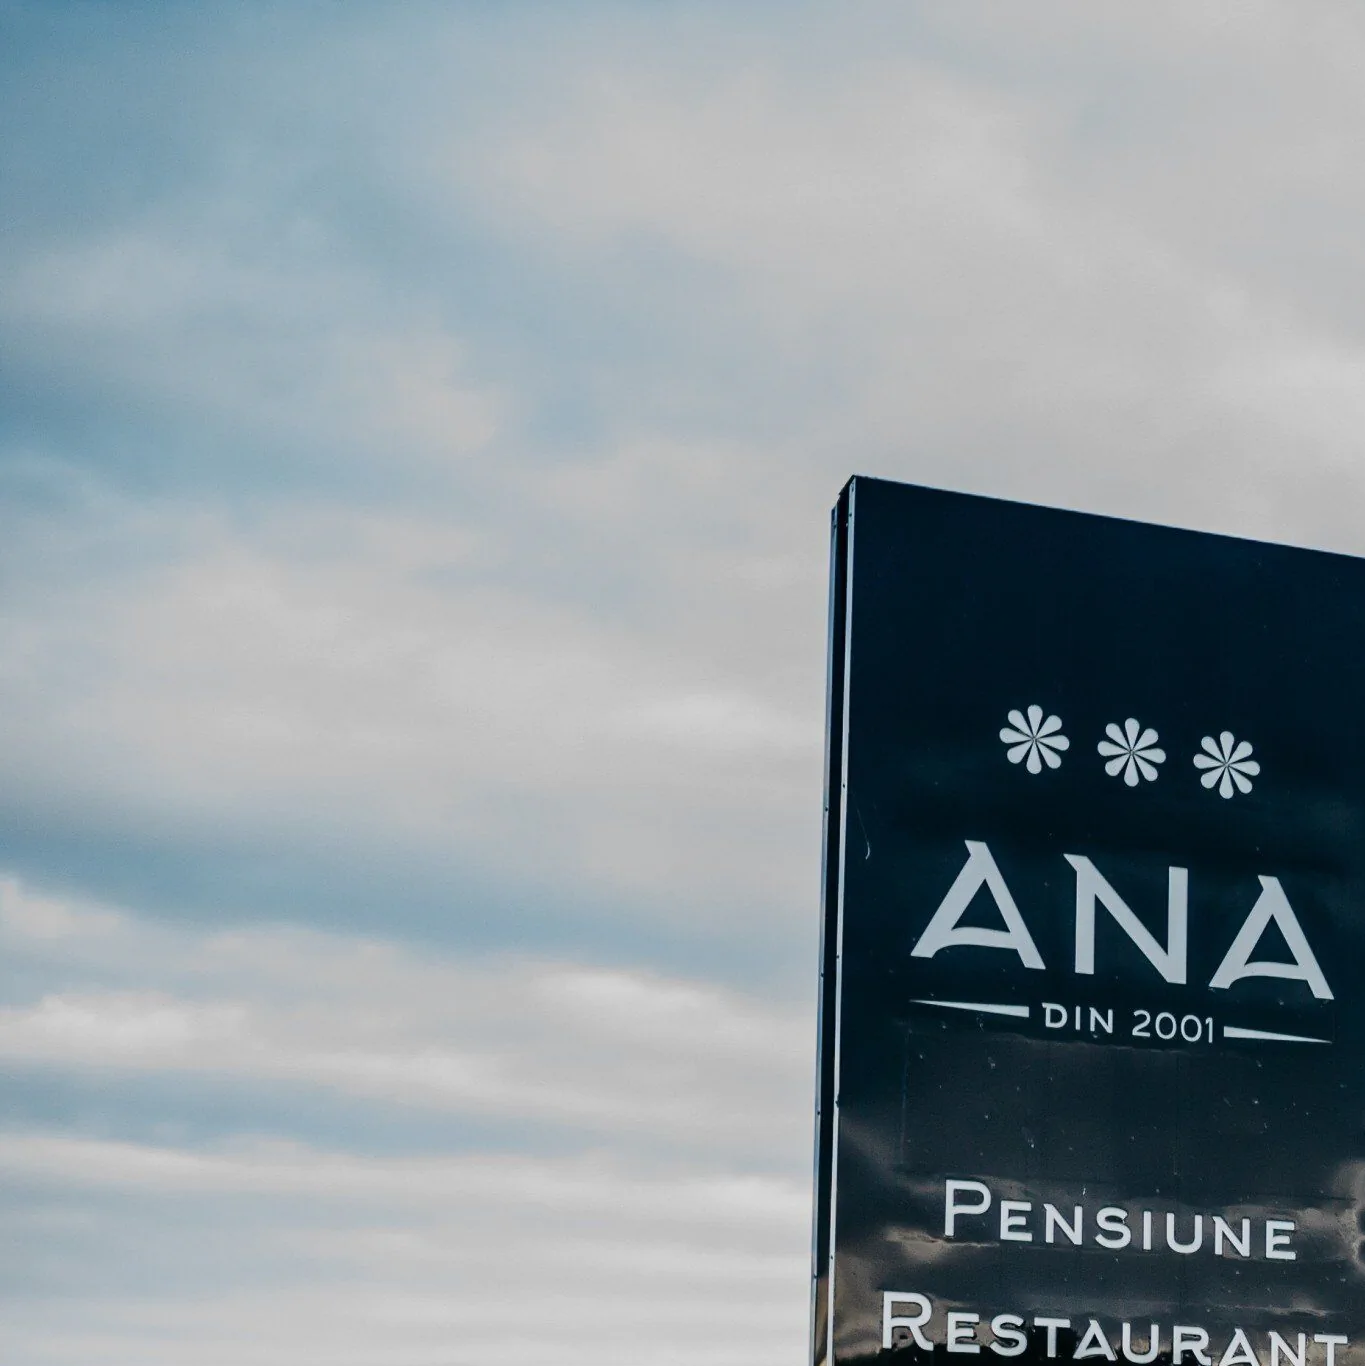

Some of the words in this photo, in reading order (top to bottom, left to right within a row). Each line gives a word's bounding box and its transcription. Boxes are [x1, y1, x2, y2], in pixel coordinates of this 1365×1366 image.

[911, 840, 1334, 999] ANA
[1041, 1002, 1114, 1034] DIN
[1131, 1009, 1214, 1044] 2001
[944, 1179, 1297, 1261] PENSIUNE
